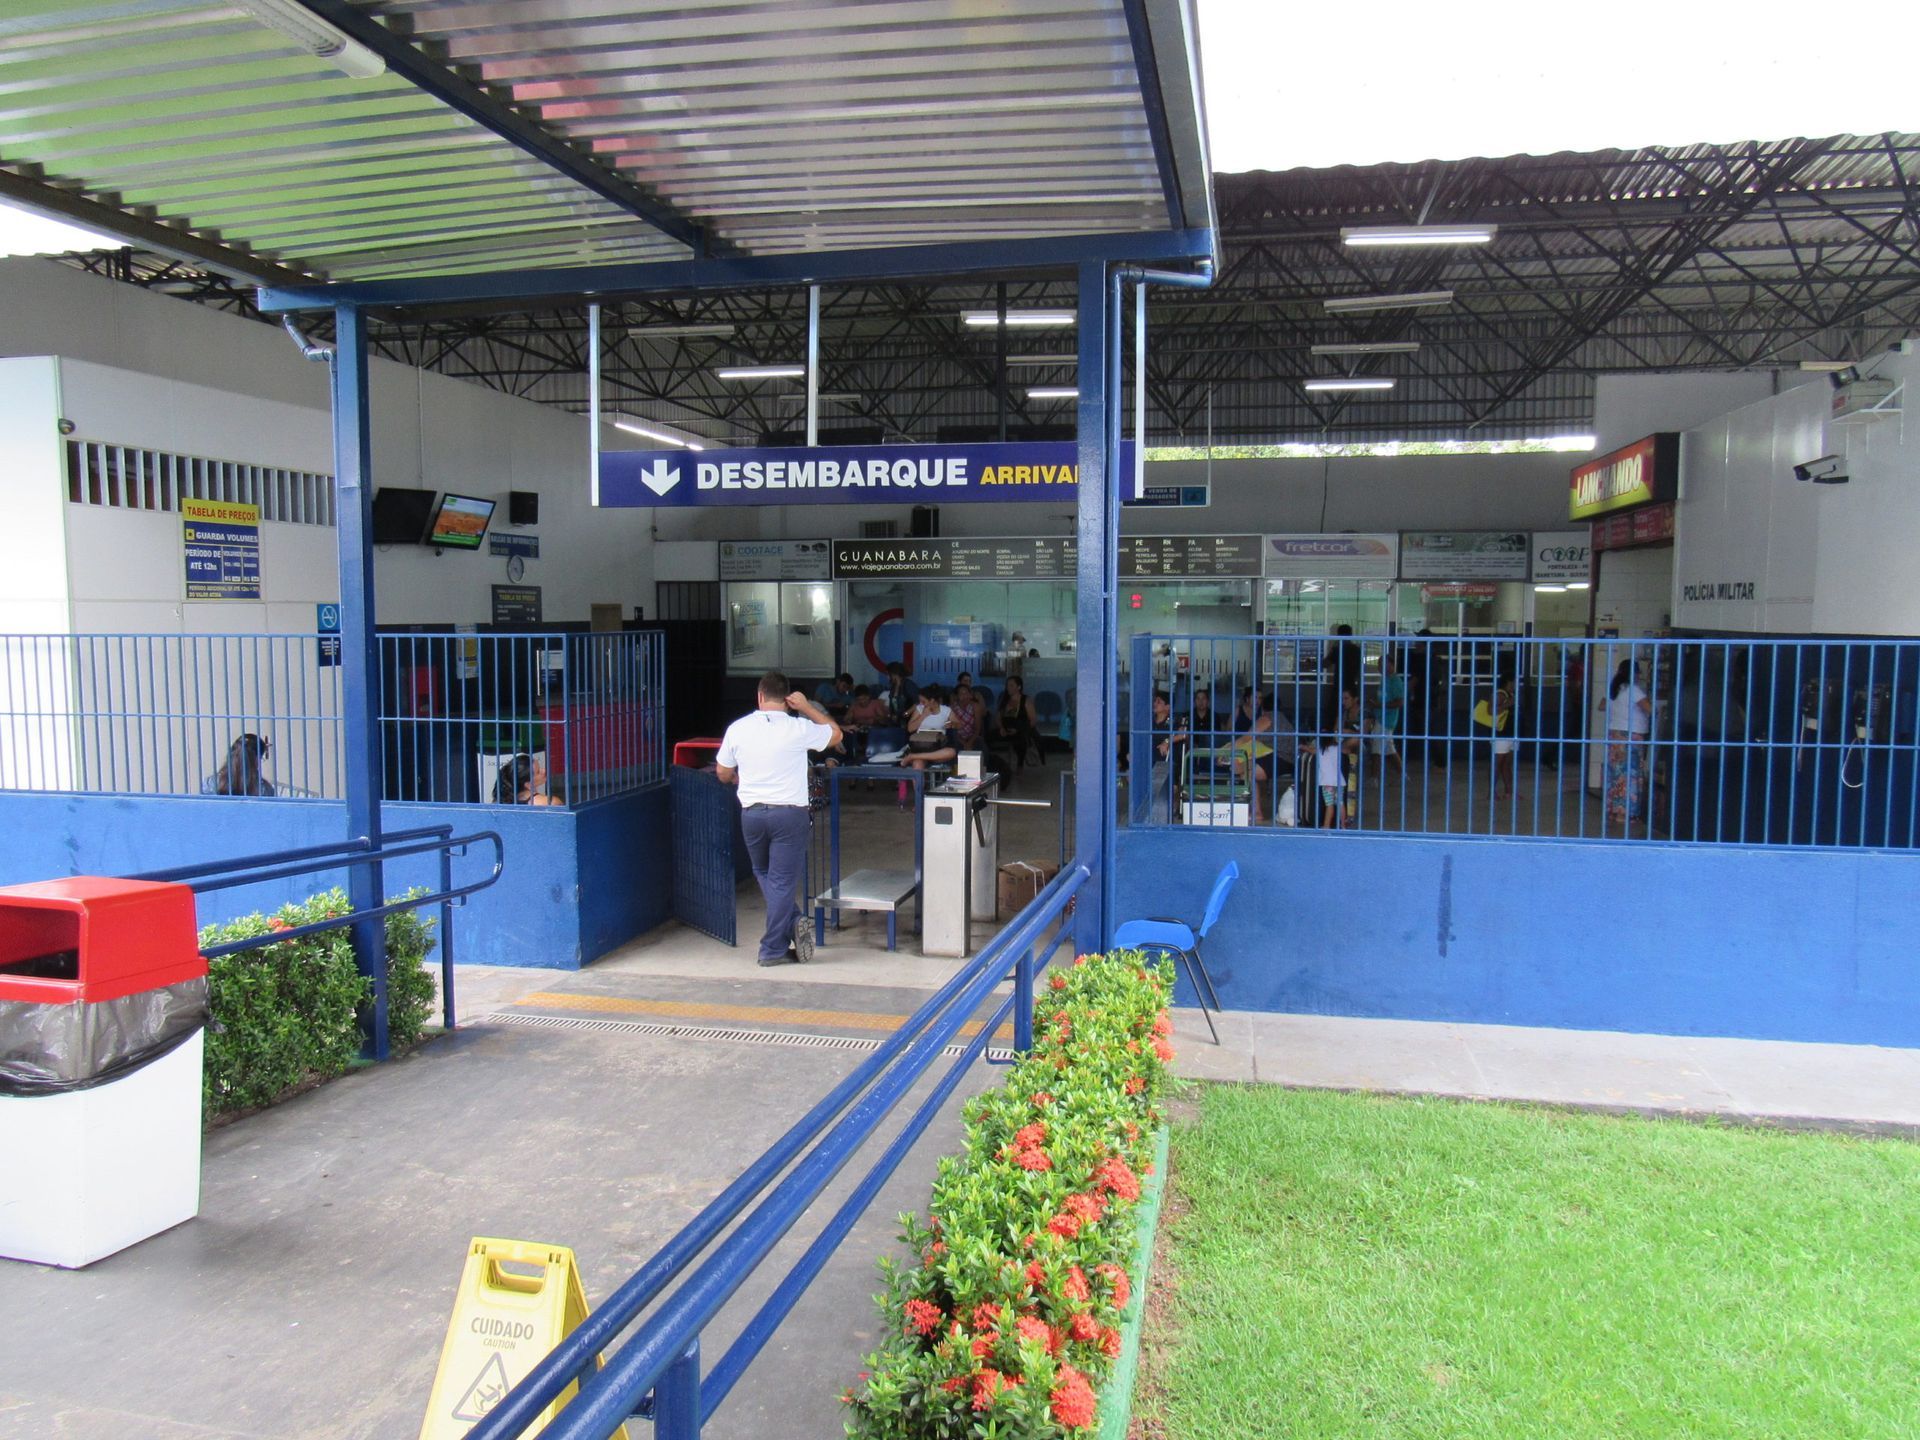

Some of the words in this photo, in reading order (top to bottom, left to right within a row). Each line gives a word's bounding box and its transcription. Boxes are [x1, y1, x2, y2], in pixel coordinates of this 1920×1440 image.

[697, 458, 968, 489] DESEMBARQUE
[1576, 453, 1642, 508] LANCHANDO
[187, 506, 215, 518] TABELA
[217, 509, 227, 518] DE
[229, 510, 256, 522] PREÇOS
[196, 531, 225, 541] GUARDA
[227, 533, 258, 542] VOLUMES
[185, 548, 212, 558] PERÍODO
[213, 550, 222, 558] DE
[1285, 542, 1351, 552] fretcar
[840, 550, 941, 562] GUANABARA
[190, 561, 202, 570] ATÉ
[1684, 581, 1715, 601] POLÍCIA
[1717, 582, 1754, 601] MILITAR
[471, 1317, 534, 1340] CUIDADO
[483, 1338, 516, 1350] CAUTION
